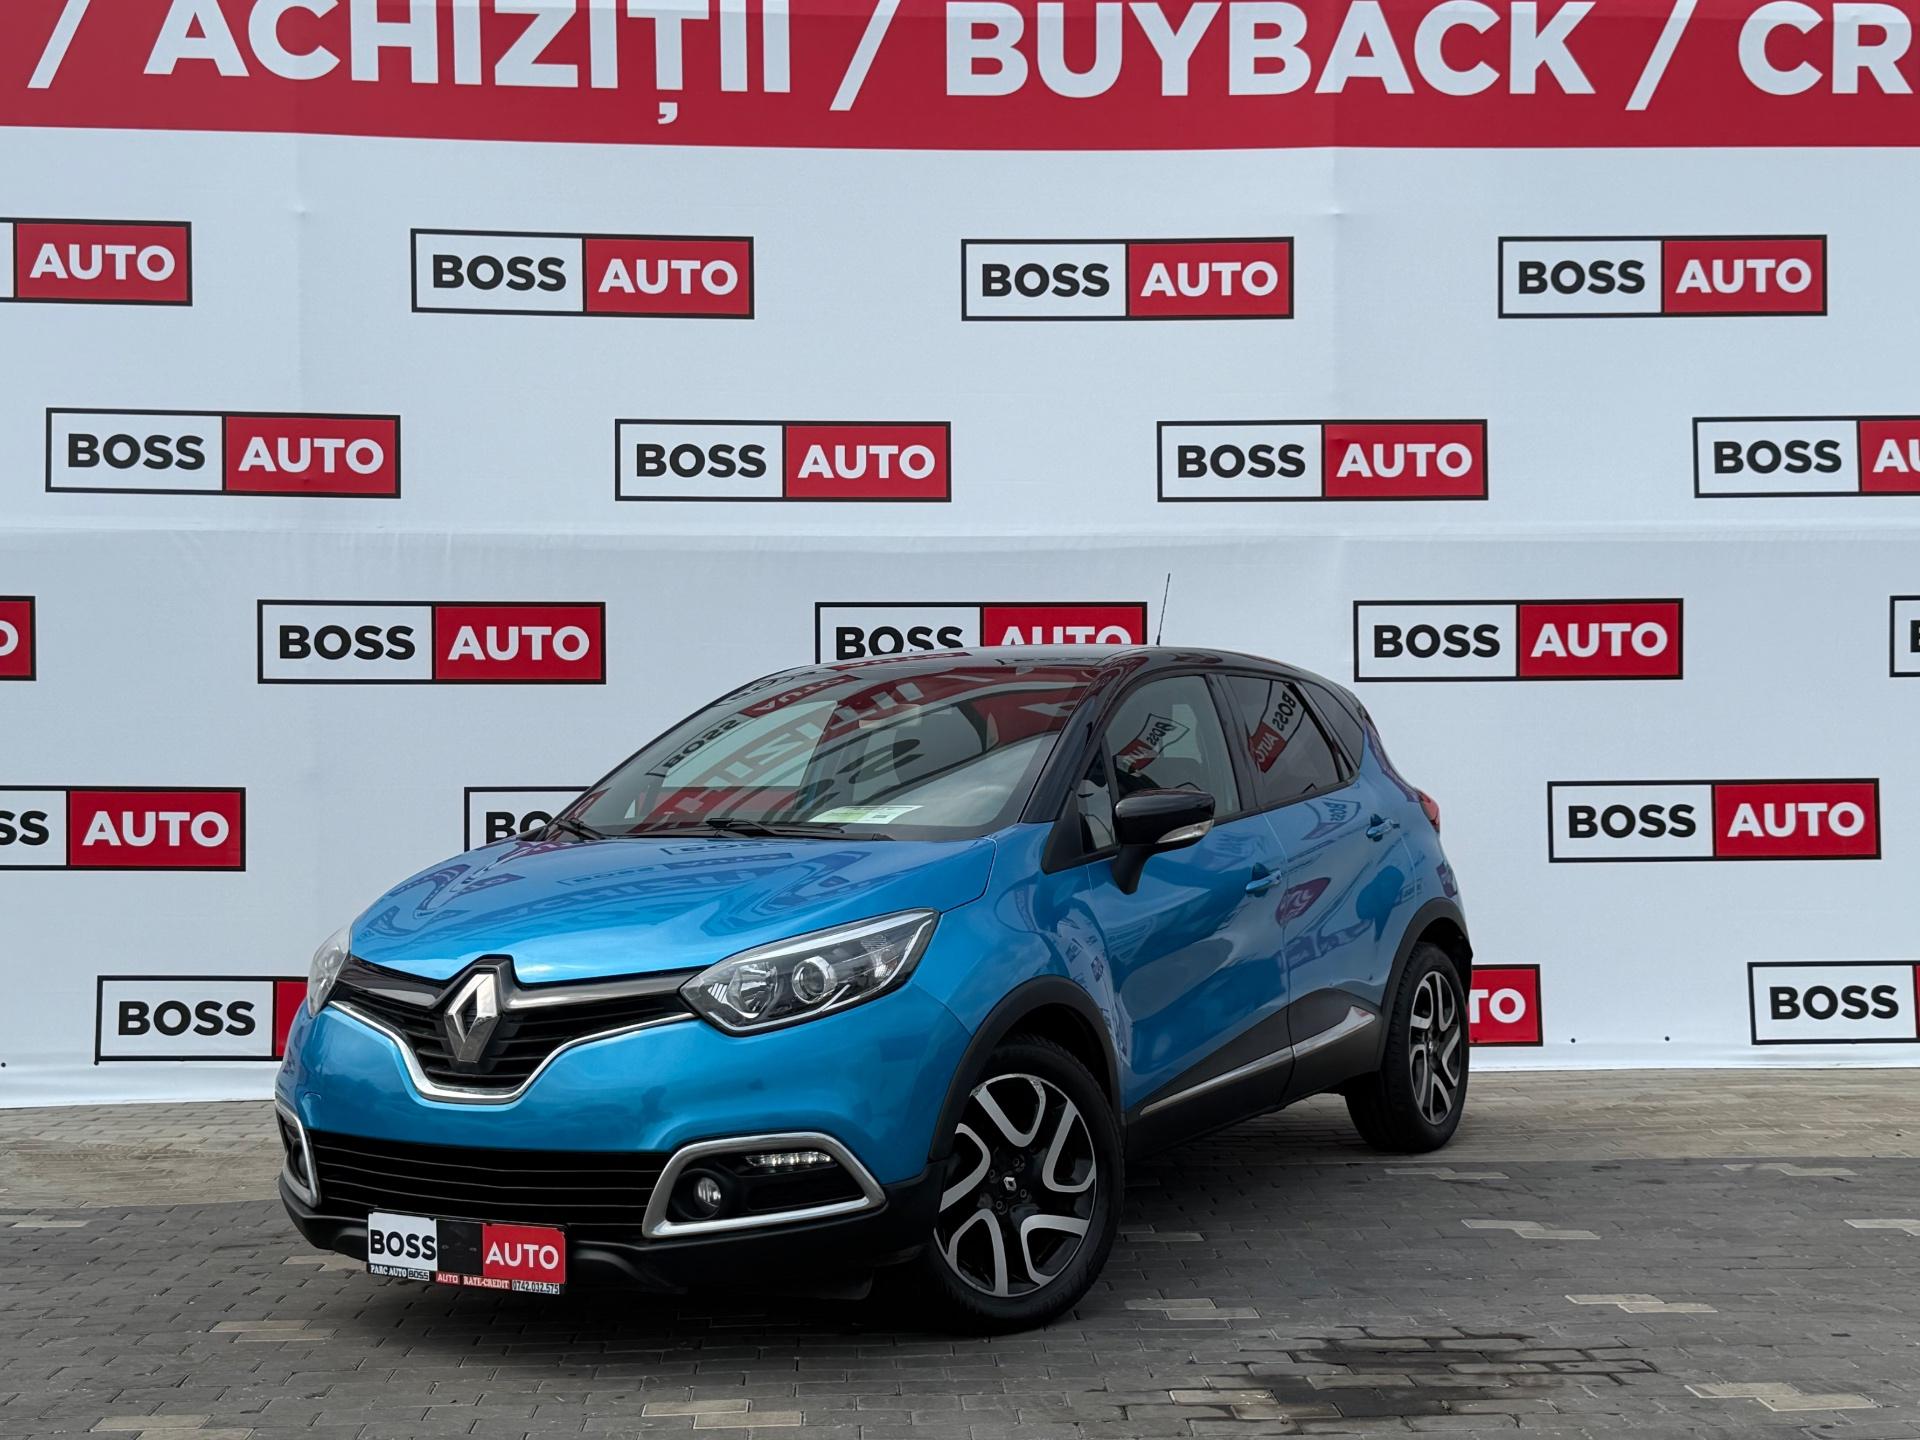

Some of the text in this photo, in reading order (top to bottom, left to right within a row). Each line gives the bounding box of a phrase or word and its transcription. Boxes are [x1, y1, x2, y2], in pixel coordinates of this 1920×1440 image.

[946, 0, 1596, 98] BUYBACK
[29, 243, 176, 282] AUTO
[432, 254, 738, 296] BOSS AUTO
[981, 260, 1278, 298] BOSS AUTO
[1517, 258, 1812, 295] BOSS AUTO
[68, 433, 384, 475] BOSS AUTO
[635, 443, 936, 480] BOSS AUTO
[1177, 442, 1473, 479] BOSS AUTO
[1713, 439, 1842, 474] BOSS
[279, 624, 590, 661] BOSS AUTO
[835, 626, 964, 661] BOSS
[1373, 621, 1668, 659] BOSS AUTO
[82, 810, 229, 847] AUTO
[1567, 801, 1865, 839] BOSS AUTO
[118, 1000, 256, 1037] BOSS
[1769, 984, 1899, 1020] BOSS
[369, 1229, 560, 1270] BOSS AUTO
[370, 1264, 389, 1275] PARC
[388, 1268, 408, 1278] AUTO
[408, 1269, 430, 1280] BOSS
[437, 1273, 459, 1284] AUTO
